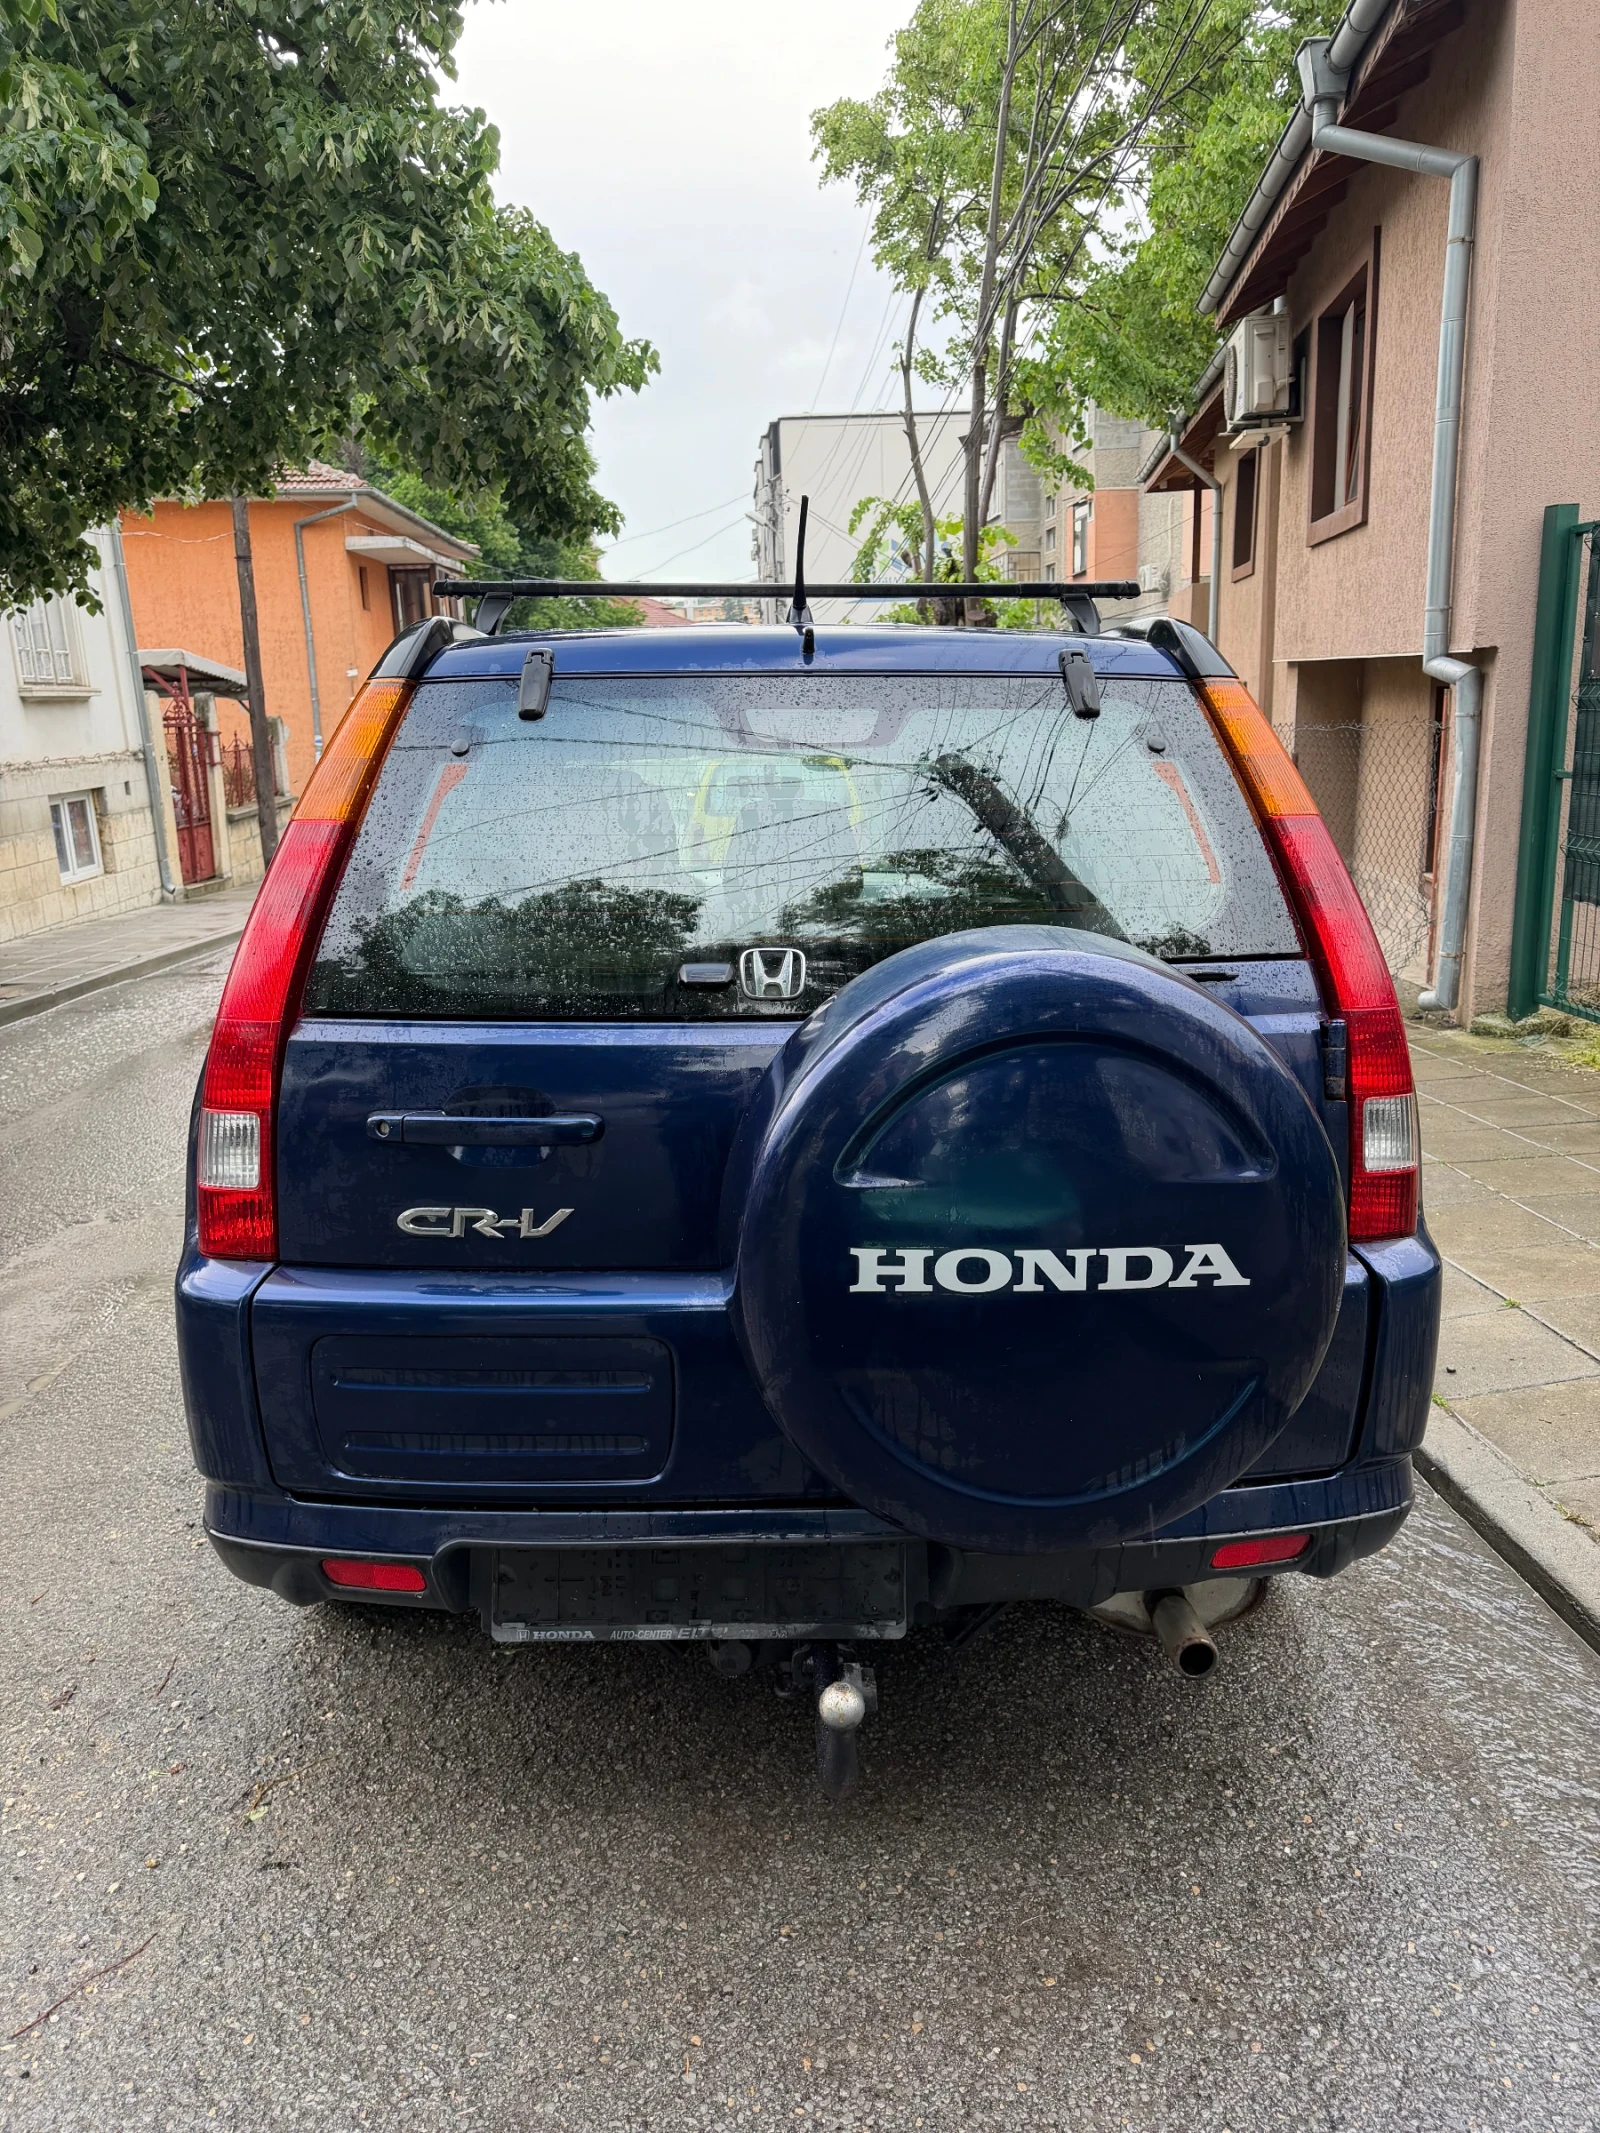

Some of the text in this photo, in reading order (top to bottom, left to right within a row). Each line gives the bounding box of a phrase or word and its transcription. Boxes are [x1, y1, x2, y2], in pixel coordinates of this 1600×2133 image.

[397, 1207, 575, 1239] CR-V
[849, 1243, 1251, 1294] HONDA
[532, 1630, 595, 1640] HONDA
[610, 1629, 673, 1640] AUTO-CENTER
